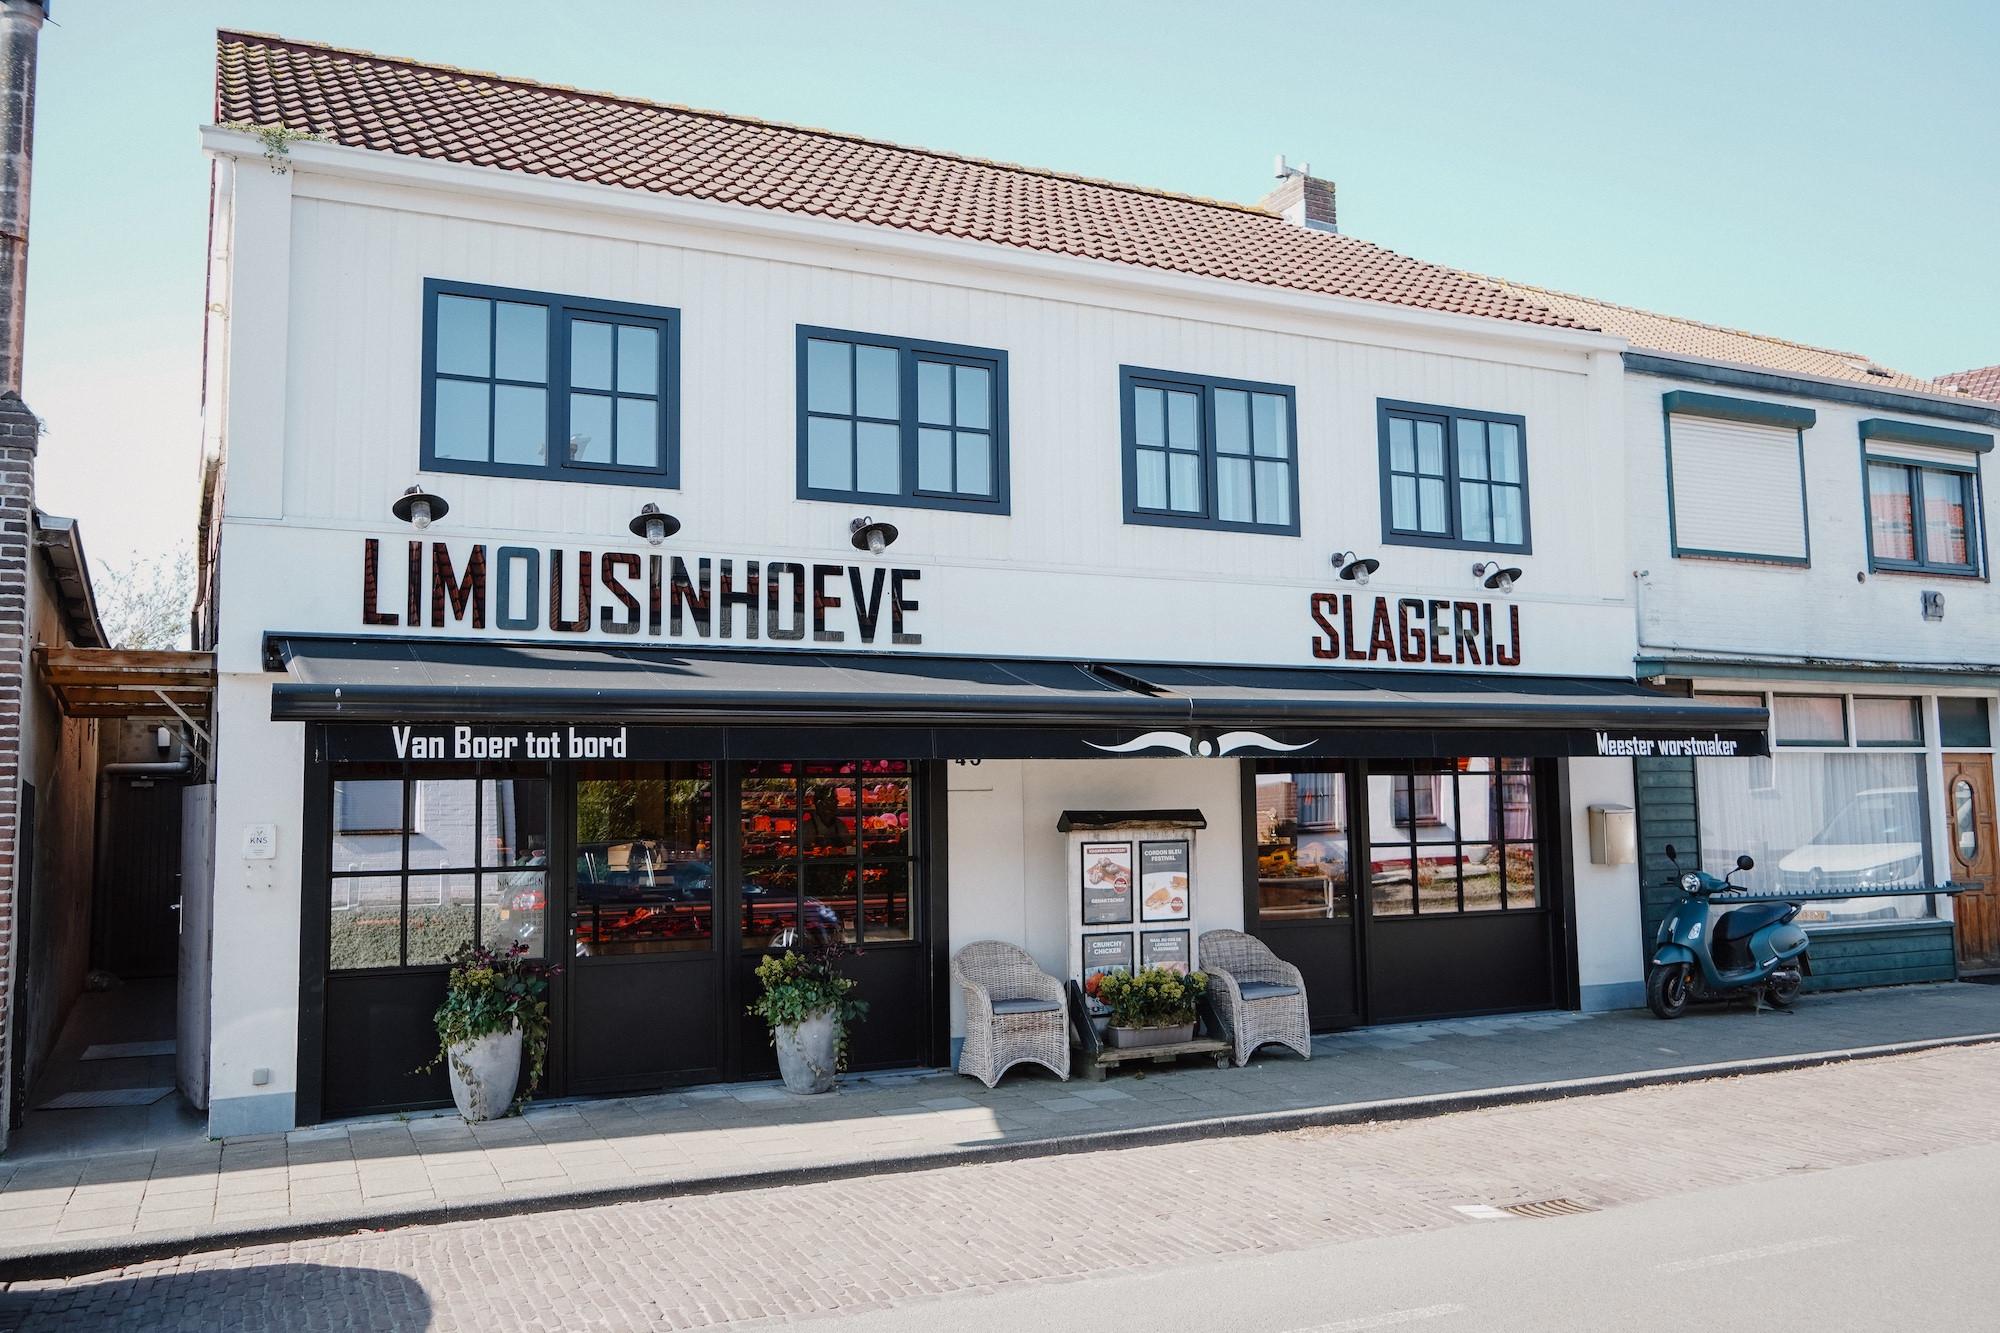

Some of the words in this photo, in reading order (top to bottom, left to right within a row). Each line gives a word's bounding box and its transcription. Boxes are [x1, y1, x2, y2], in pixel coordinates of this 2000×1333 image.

[363, 538, 922, 645] LIMOUSINHOEVE
[1311, 593, 1521, 667] SLAGERIJ
[392, 726, 445, 759] Van
[454, 726, 518, 758] Boer
[526, 731, 560, 758] tot
[568, 727, 627, 758] bord
[1596, 732, 1654, 756] Meester
[1657, 733, 1737, 756] worstmaker
